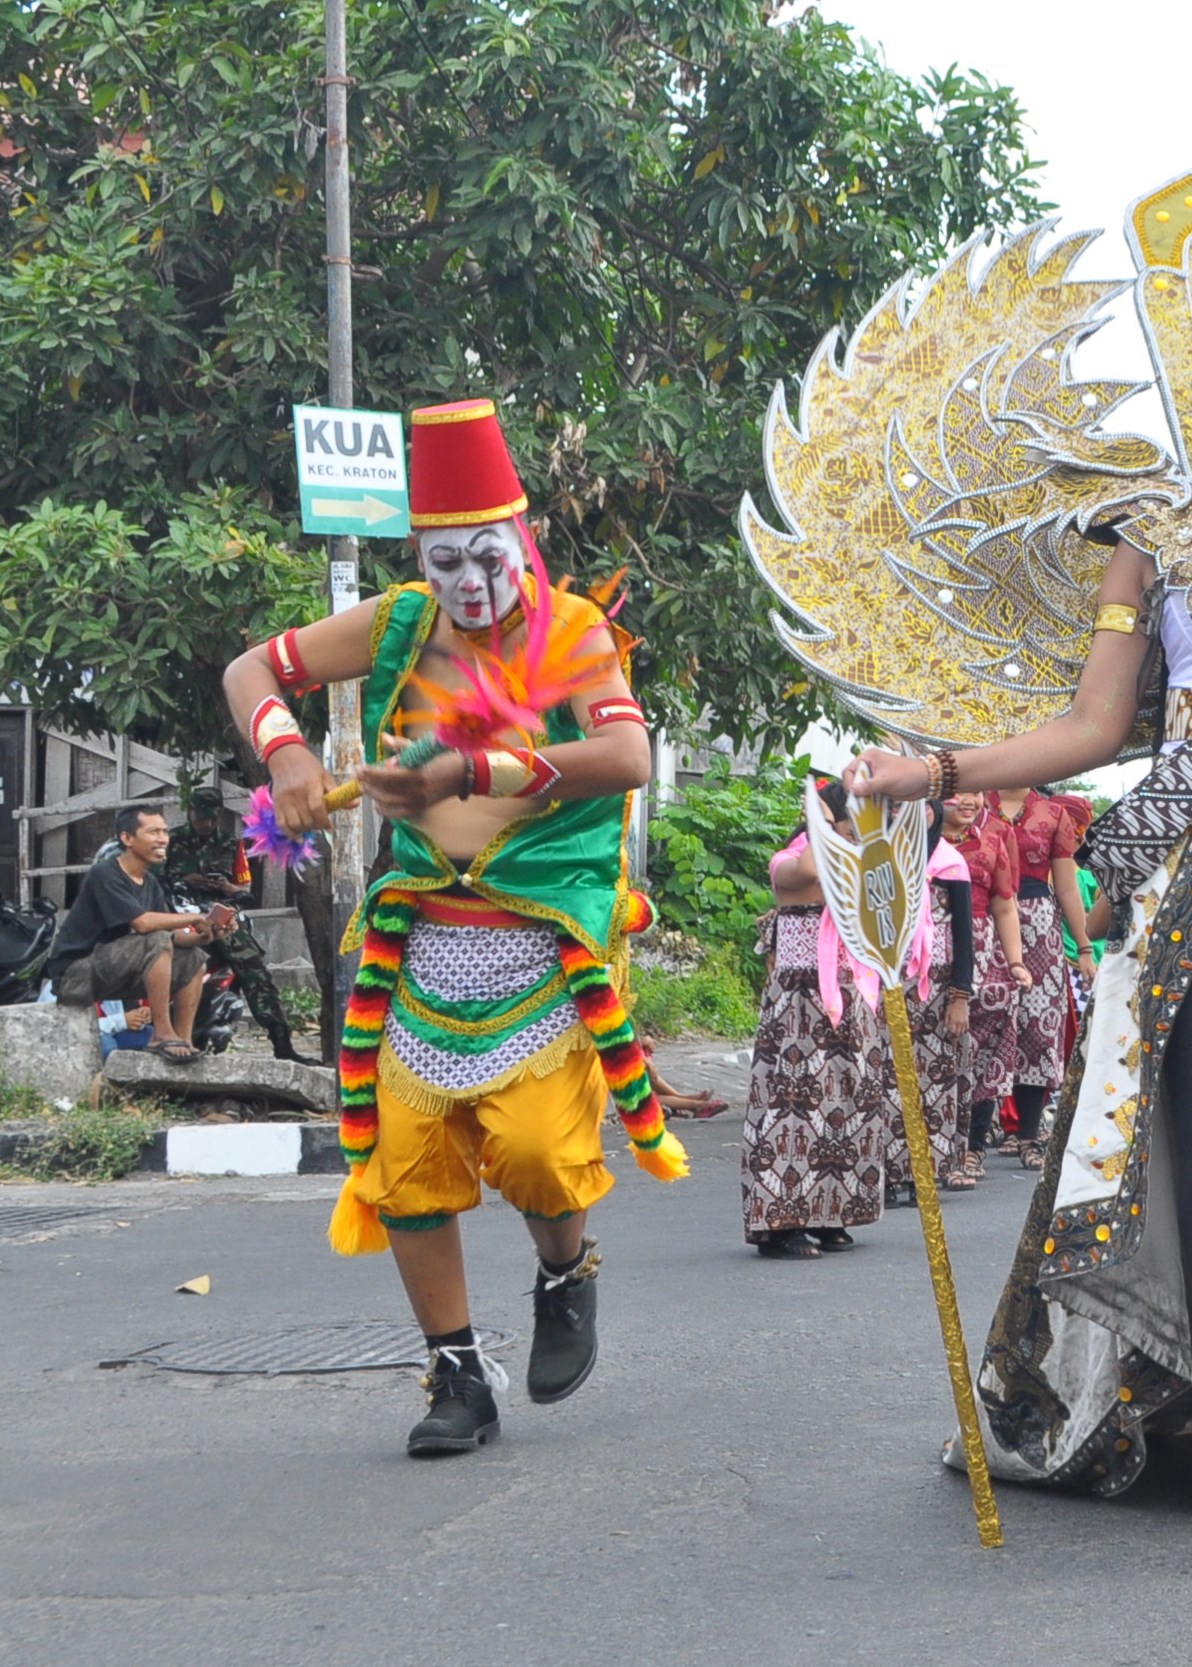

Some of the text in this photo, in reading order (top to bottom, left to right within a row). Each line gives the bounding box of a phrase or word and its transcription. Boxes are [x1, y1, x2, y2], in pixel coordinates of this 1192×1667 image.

[303, 418, 395, 459] KUA
[307, 464, 397, 480] KEC. KRATON
